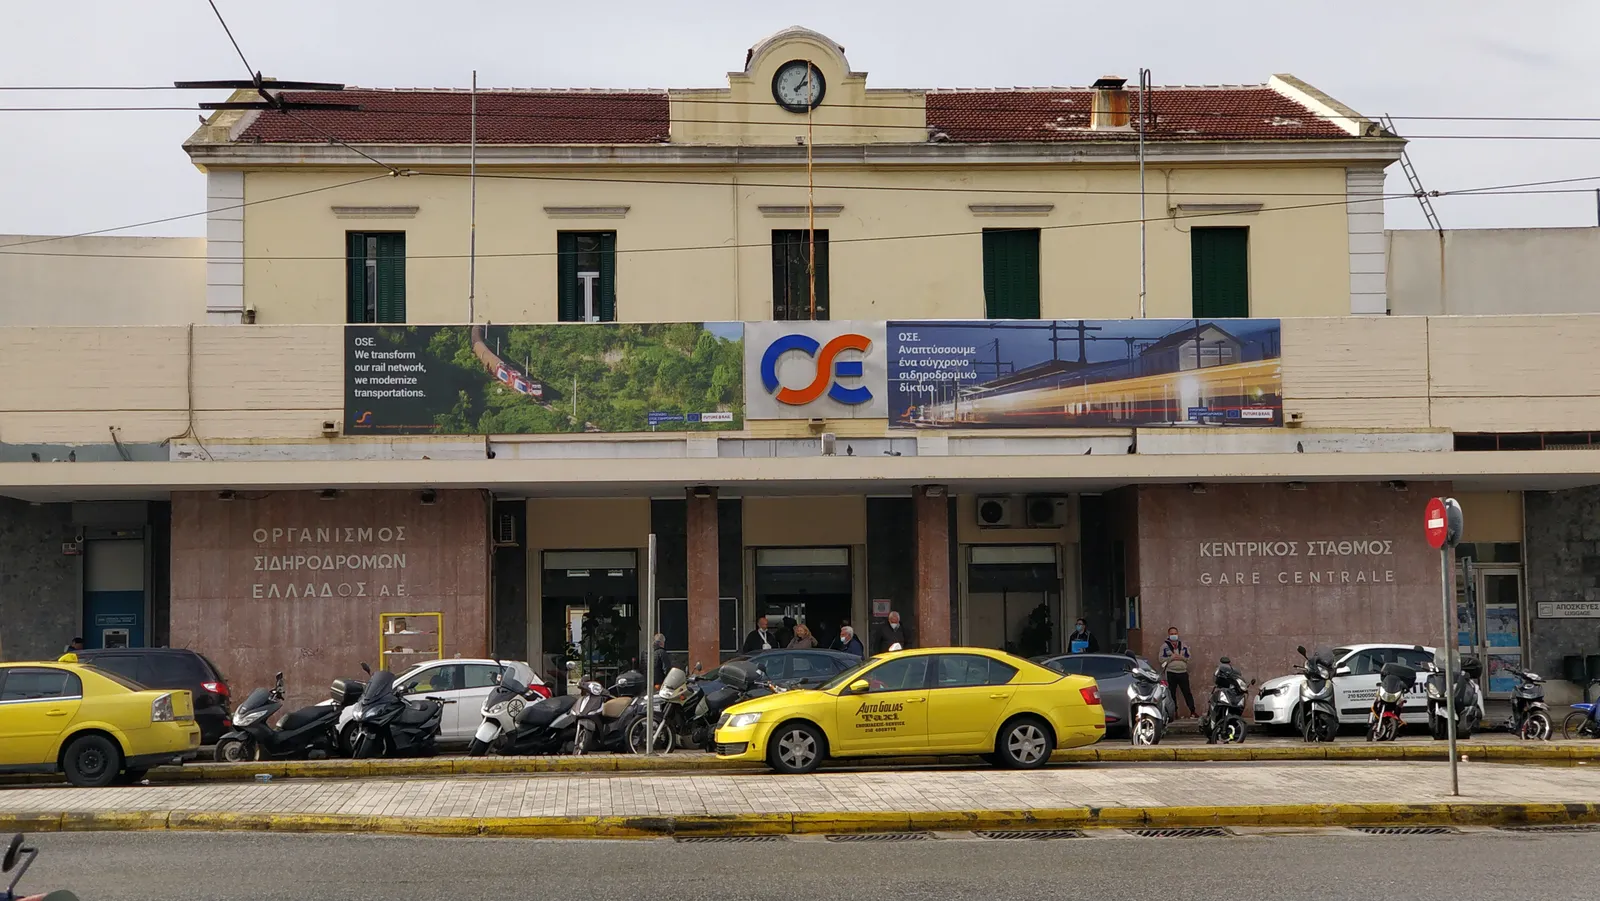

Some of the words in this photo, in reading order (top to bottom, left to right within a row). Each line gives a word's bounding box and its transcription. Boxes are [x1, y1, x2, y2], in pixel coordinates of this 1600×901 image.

[354, 337, 377, 347] OSE.
[898, 333, 921, 342] ΟΣΕ.
[354, 350, 370, 359] We
[371, 350, 416, 359] transform
[898, 345, 976, 356] Αναπτύσσουμε
[354, 364, 370, 372] our
[371, 362, 386, 372] rail
[387, 362, 427, 373] network,
[898, 357, 917, 367] ένα
[919, 357, 969, 369] σύγχρονο
[354, 376, 369, 385] we
[369, 375, 417, 385] modernize
[899, 370, 977, 382] σιδηροδρομικό
[899, 382, 937, 392] δίκτυο.
[354, 388, 426, 399] transportations.
[253, 526, 406, 543] ΟΡΓΑΝΙΣΜΟΣ
[1200, 541, 1298, 557] ΚΕΝΤΡΙΚΟΣ
[1307, 540, 1393, 556] ΣΤΑΘΜΟΣ
[253, 553, 406, 571] ΣΙΔΗΡΟΔΡΟΜΩΝ
[1200, 572, 1260, 584] GARE
[1278, 570, 1394, 584] CENTRALE
[252, 582, 367, 599] ΕΛΛΑΔΟΣ
[855, 702, 878, 716] AUTO
[878, 701, 903, 713] GOLIAS
[862, 713, 899, 722] Taxi
